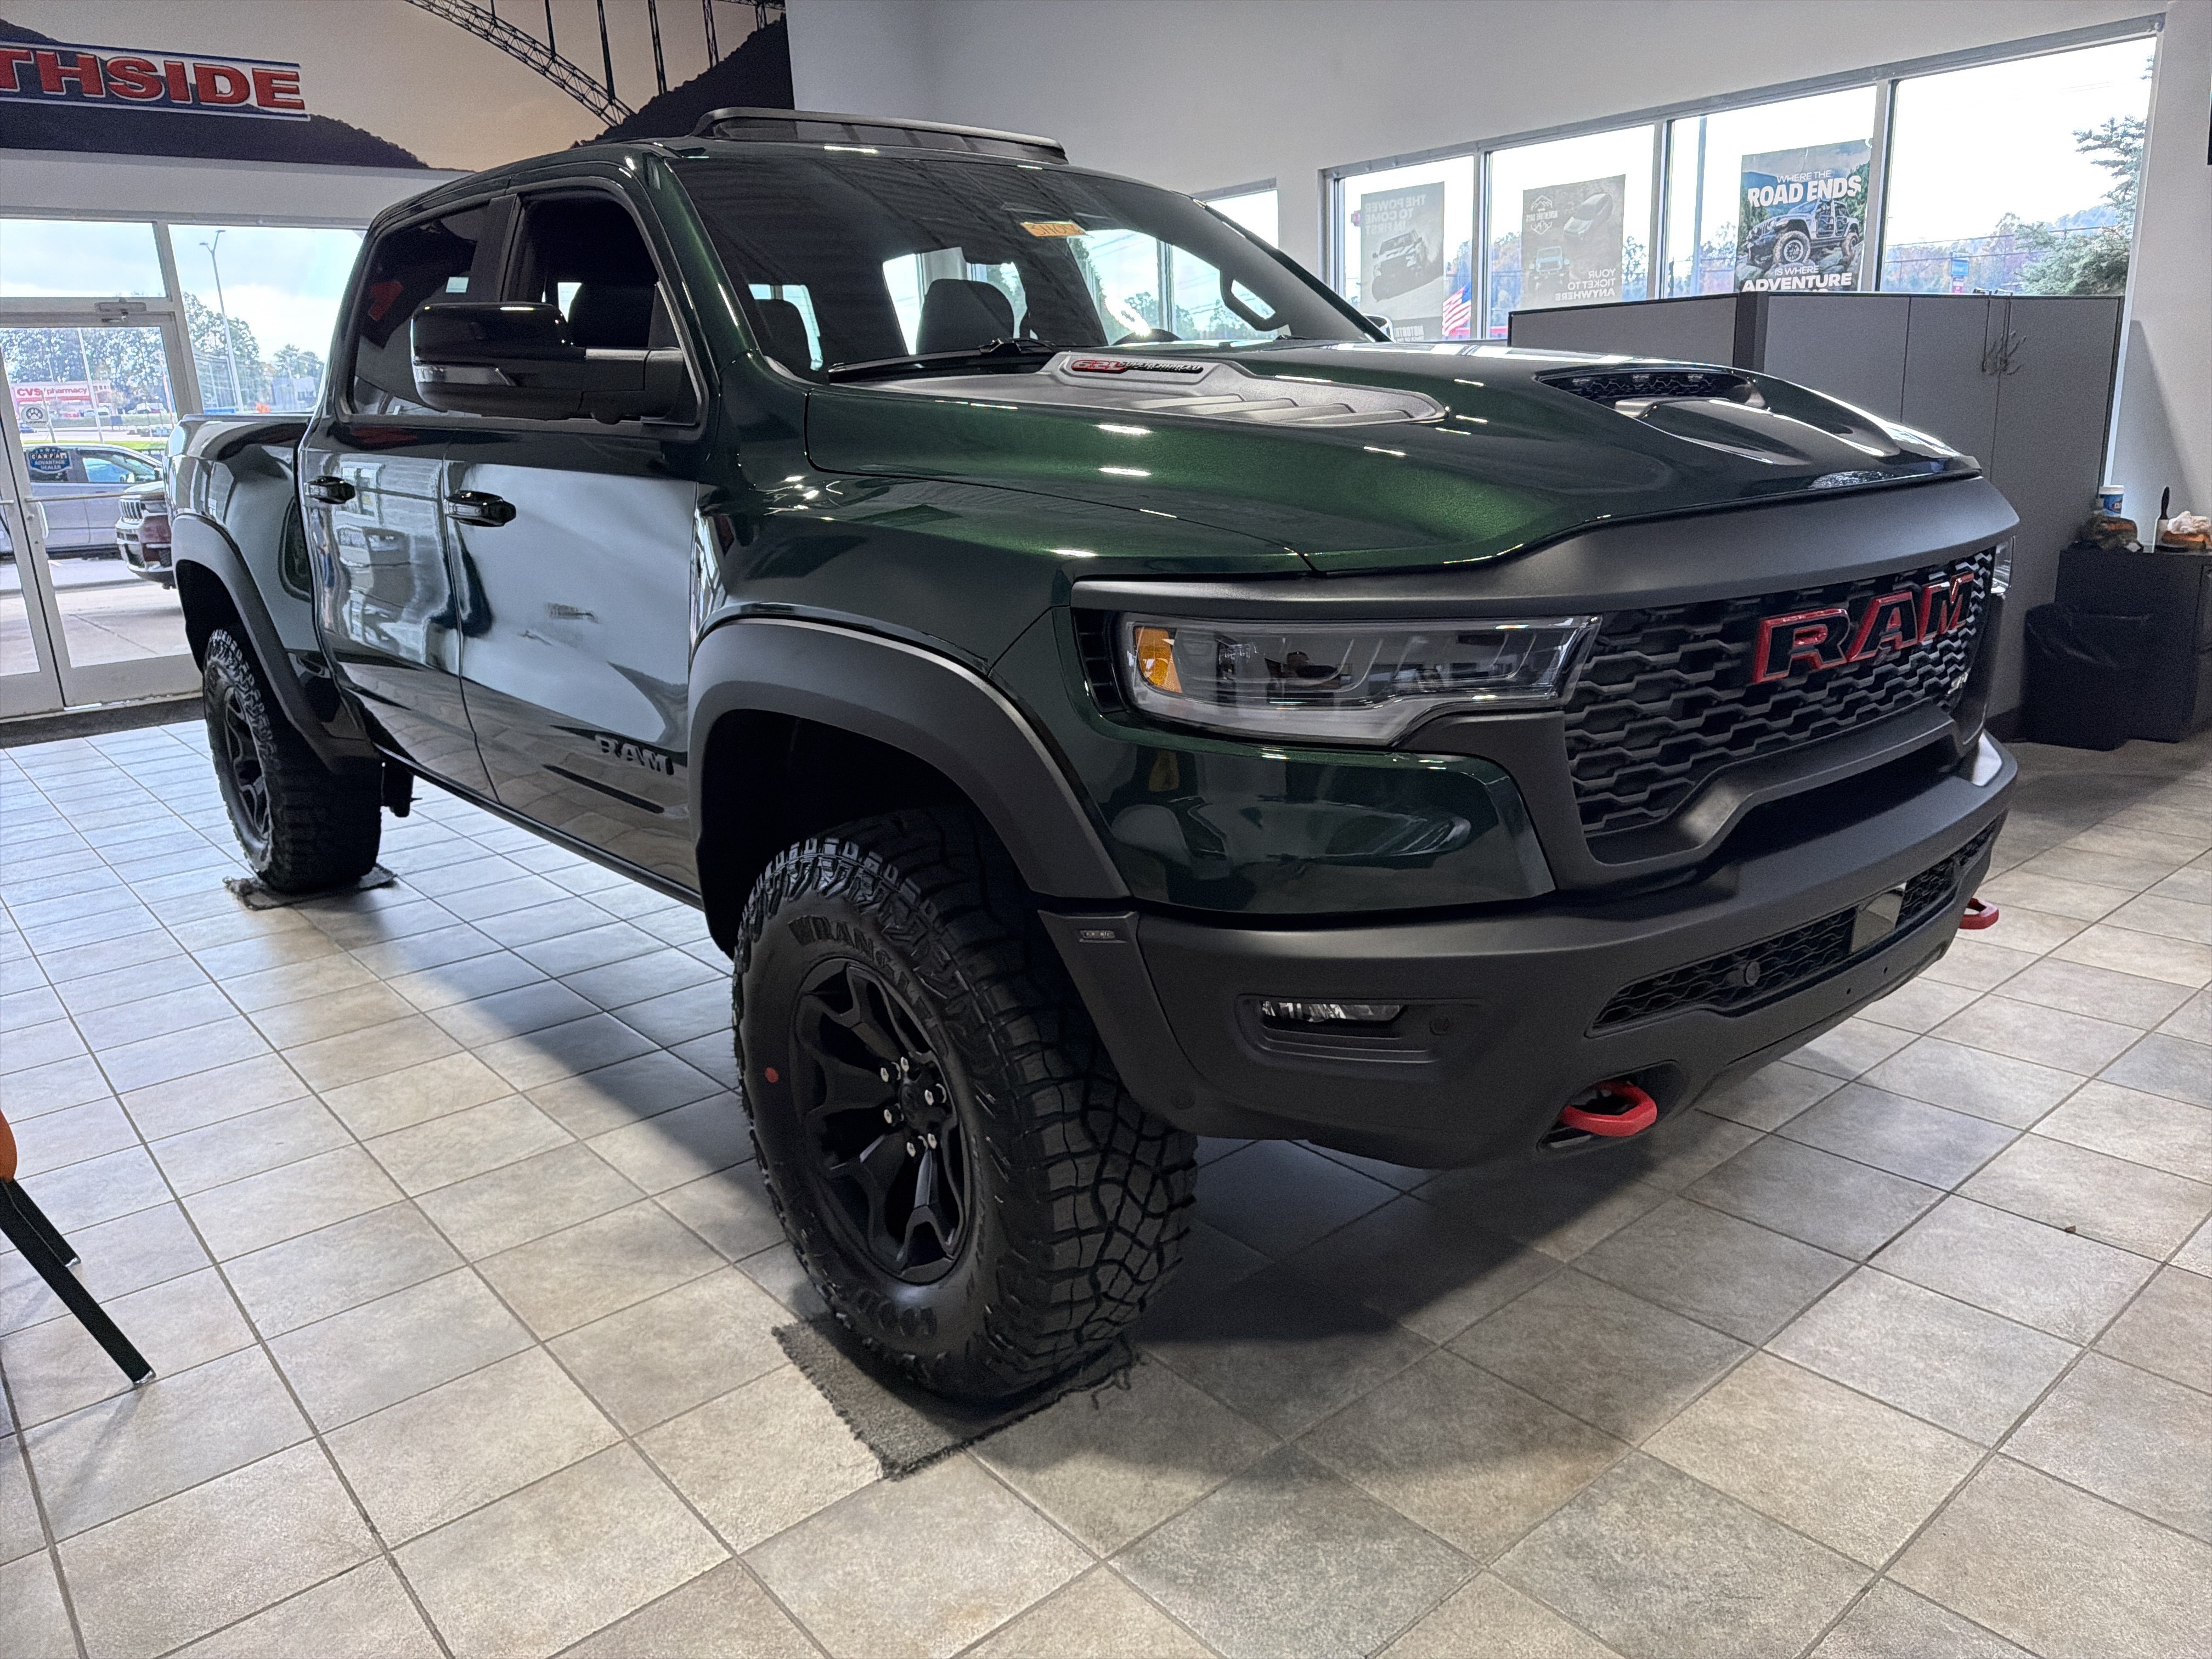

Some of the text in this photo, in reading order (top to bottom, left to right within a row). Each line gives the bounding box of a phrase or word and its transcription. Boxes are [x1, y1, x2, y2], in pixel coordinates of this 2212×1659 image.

[1776, 170, 1832, 183] WHERE THE
[1747, 175, 1862, 207] ROAD ENDS
[1741, 272, 1853, 292] ADVENTURE
[1775, 265, 1820, 276] IS WHERE
[1751, 571, 1974, 684] RAM
[594, 733, 674, 776] RAM
